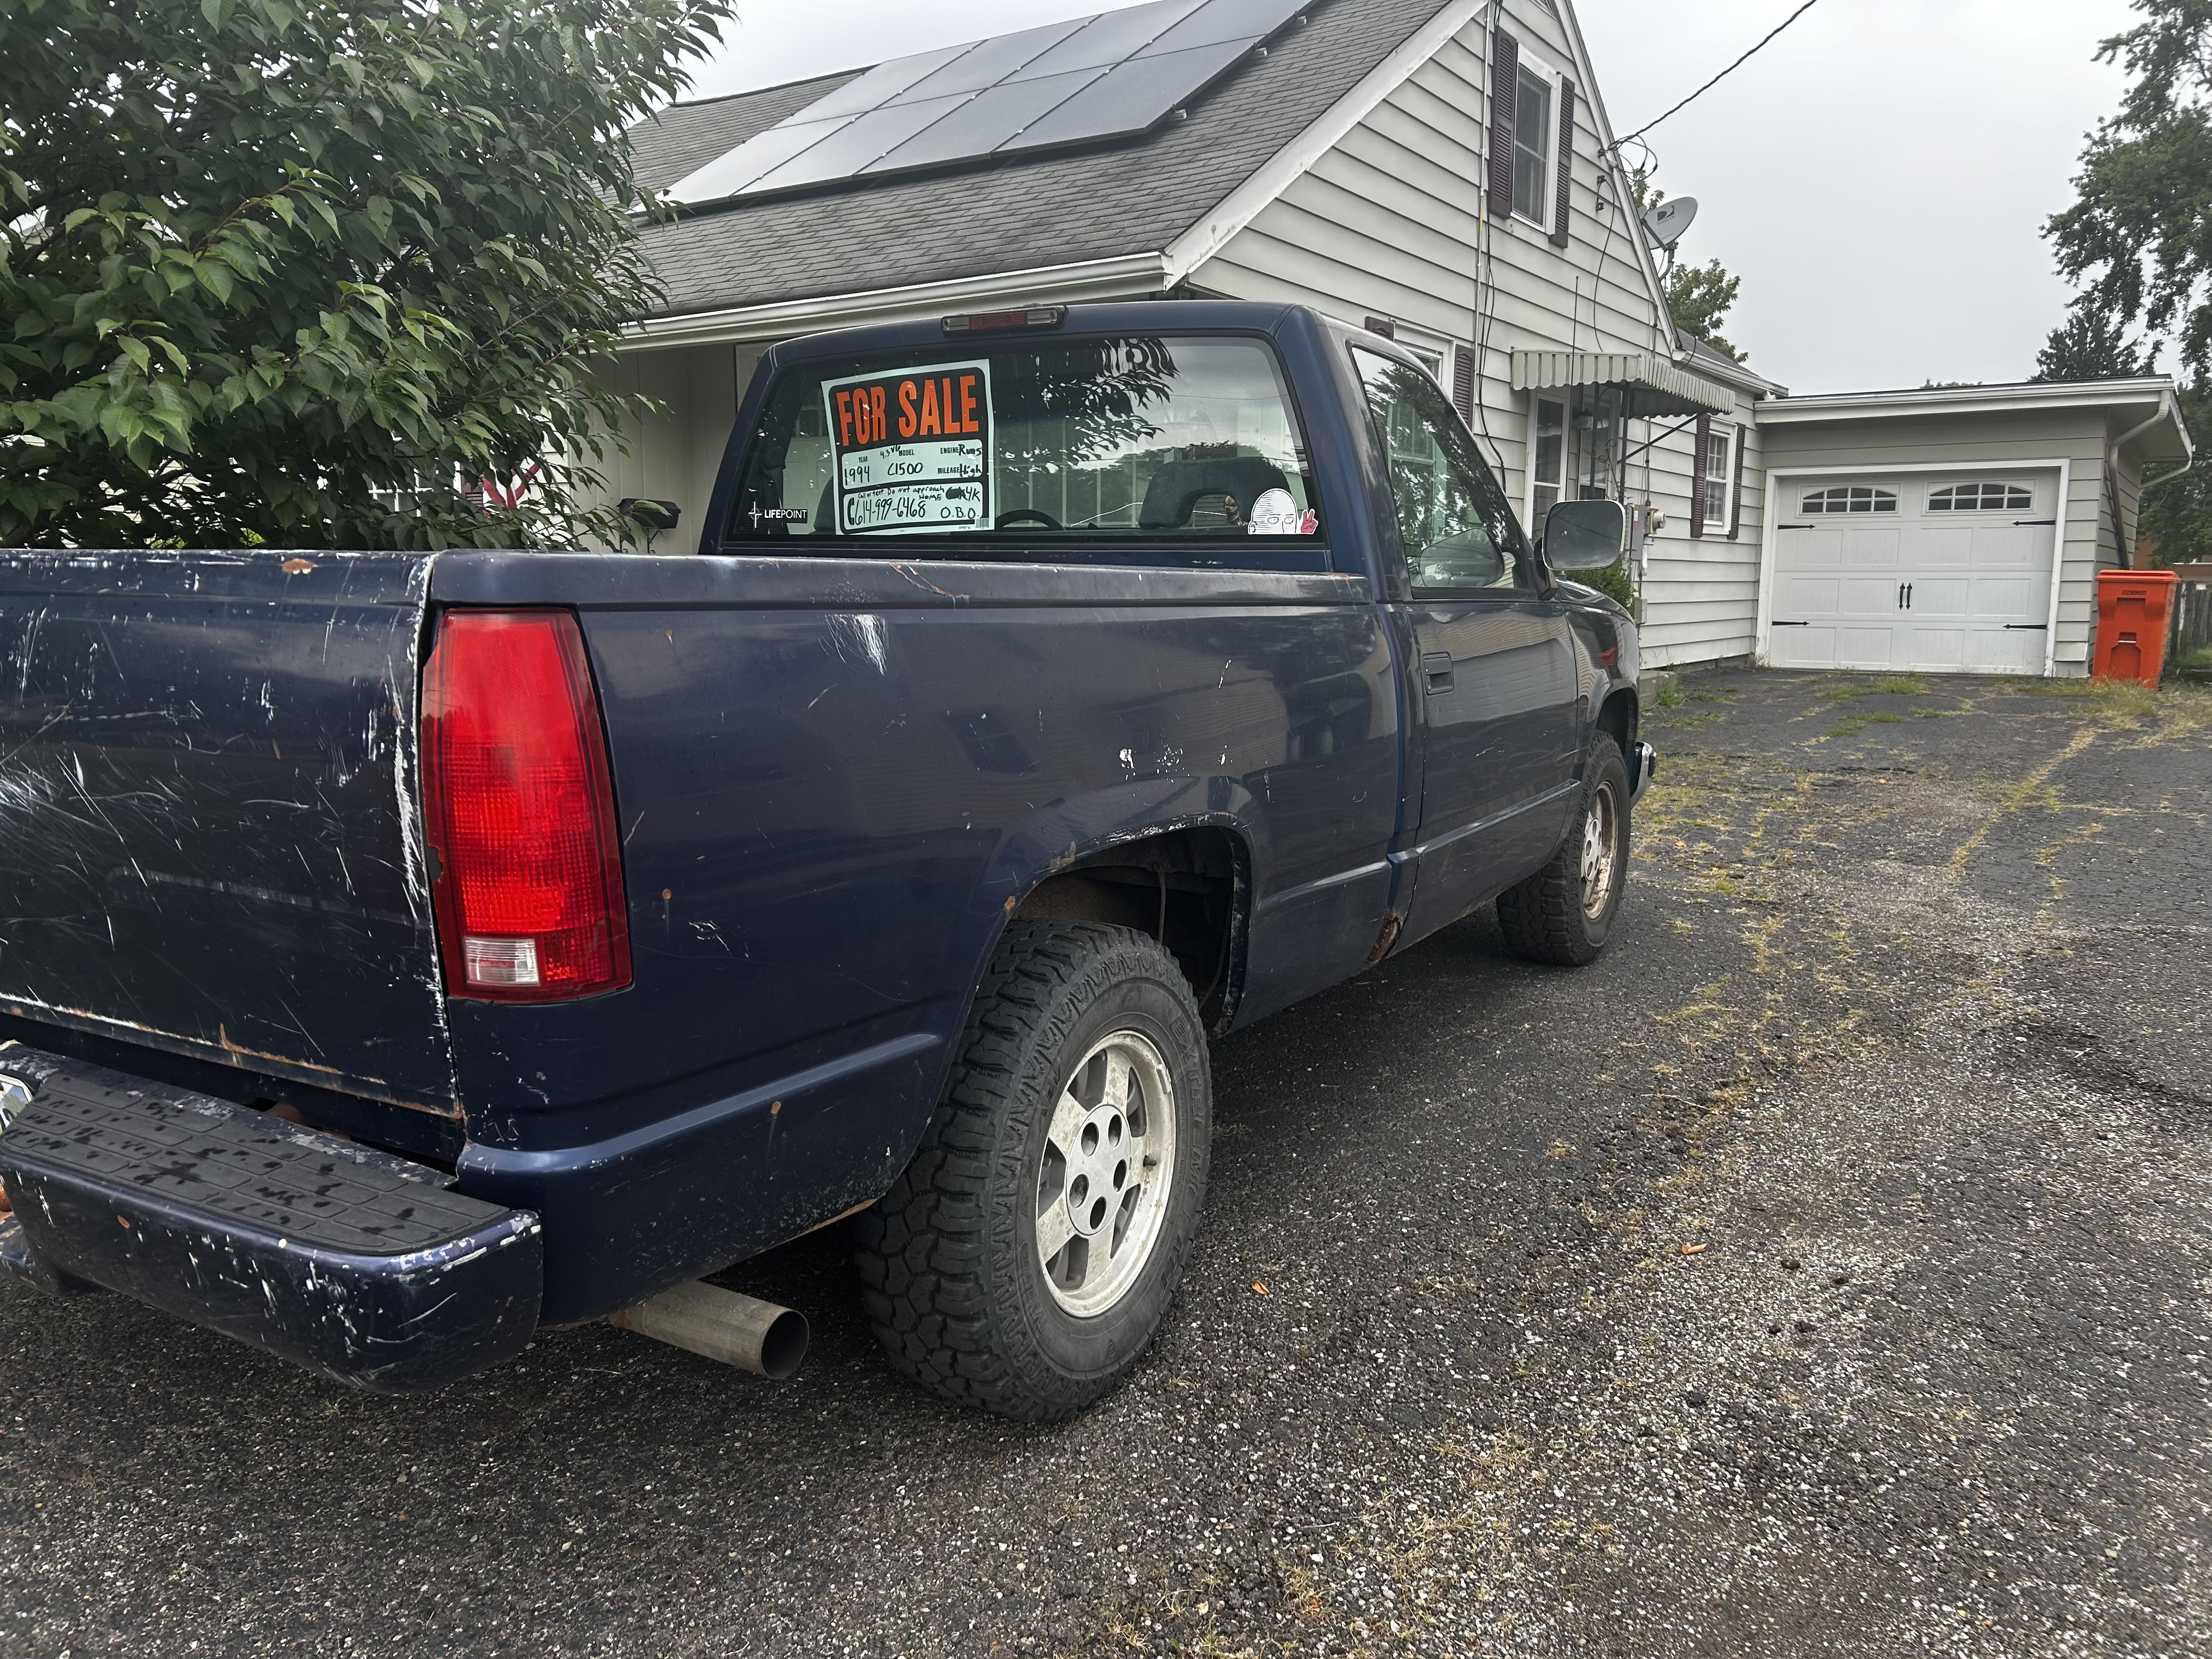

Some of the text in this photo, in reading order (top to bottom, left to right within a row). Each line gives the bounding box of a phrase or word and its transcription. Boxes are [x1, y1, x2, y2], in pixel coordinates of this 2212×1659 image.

[836, 375, 979, 446] FOR SALE
[880, 449, 890, 459] 4.3
[888, 462, 923, 475] C1500
[960, 463, 981, 477] High
[845, 465, 870, 486] 1994
[913, 486, 944, 494] approach
[764, 509, 808, 518] LIFEPOINT
[855, 497, 926, 525] 614-999-6468
